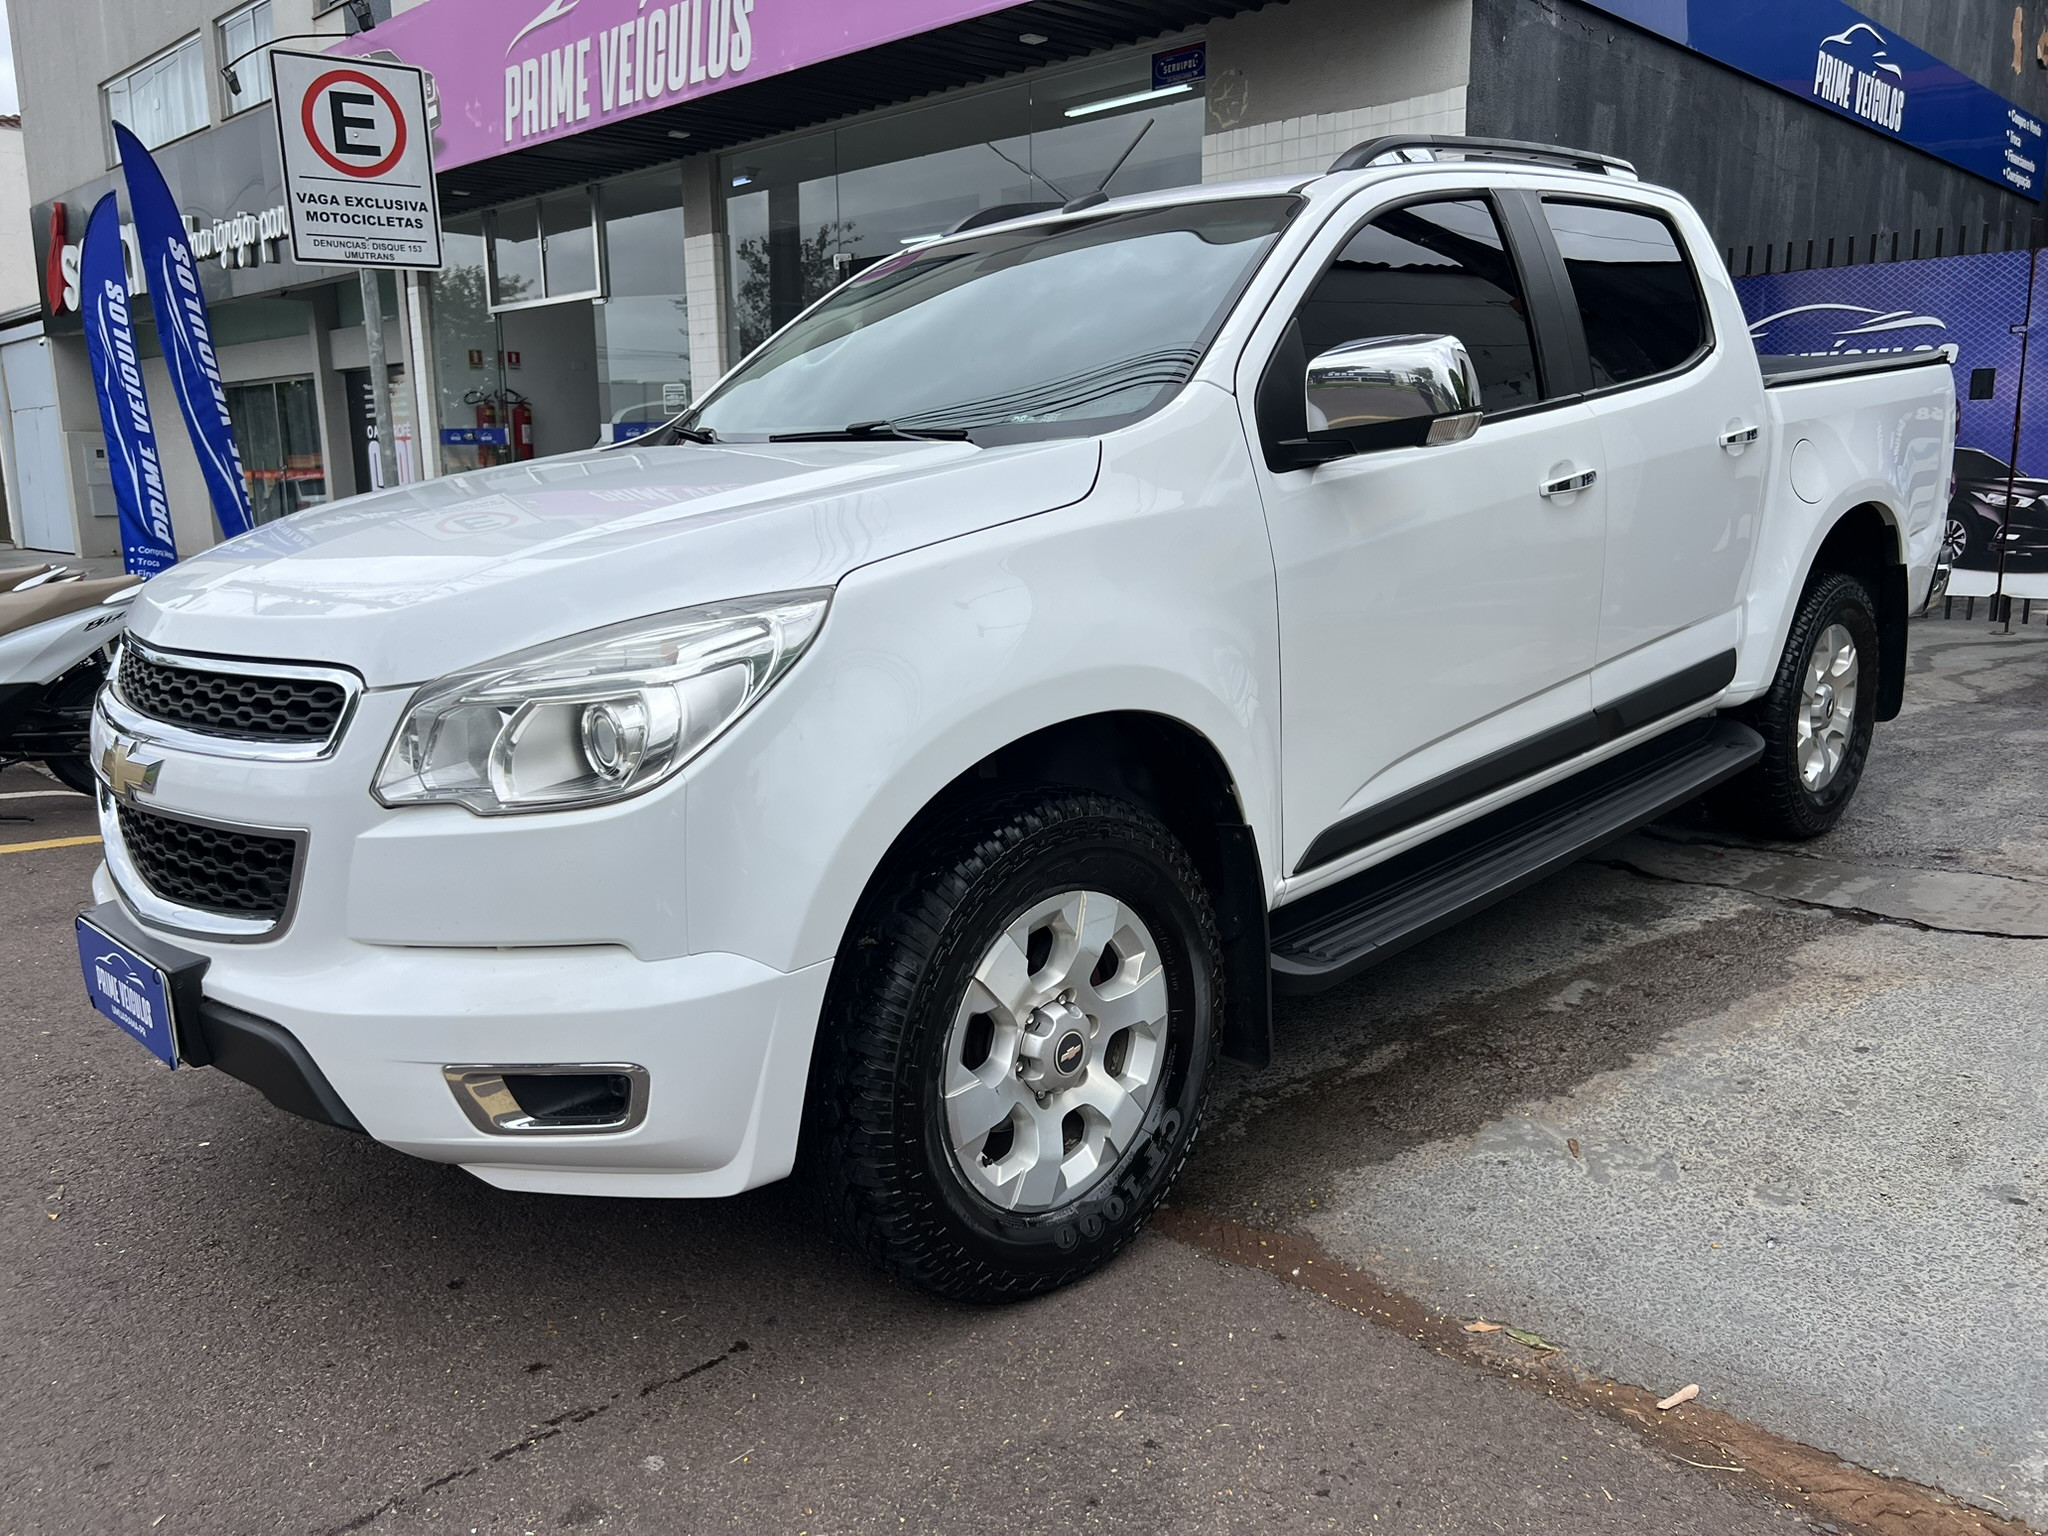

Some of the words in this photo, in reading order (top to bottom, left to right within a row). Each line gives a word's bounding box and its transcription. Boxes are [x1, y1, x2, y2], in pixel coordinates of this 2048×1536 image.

[505, 37, 591, 142] PRIME
[599, 0, 754, 112] VEÍCULOS
[1813, 50, 1854, 109] PRIME
[1855, 70, 1905, 132] VEÍCULOS
[329, 91, 382, 157] E
[296, 192, 340, 206] VAGA
[344, 196, 429, 213] EXCLUSIVA
[306, 211, 424, 229] MOTOCICLETAS
[259, 205, 290, 263] par
[313, 239, 370, 250] DENUNCIAS:
[372, 242, 406, 253] DISQUE
[408, 244, 423, 253] 153
[344, 250, 395, 261] UMUTRANS
[105, 279, 151, 434] VEÍCULOS
[140, 440, 174, 548] PRIME
[137, 557, 160, 567] Troca
[95, 964, 121, 1004] PRIME
[118, 979, 153, 1029] VEÍCULOS
